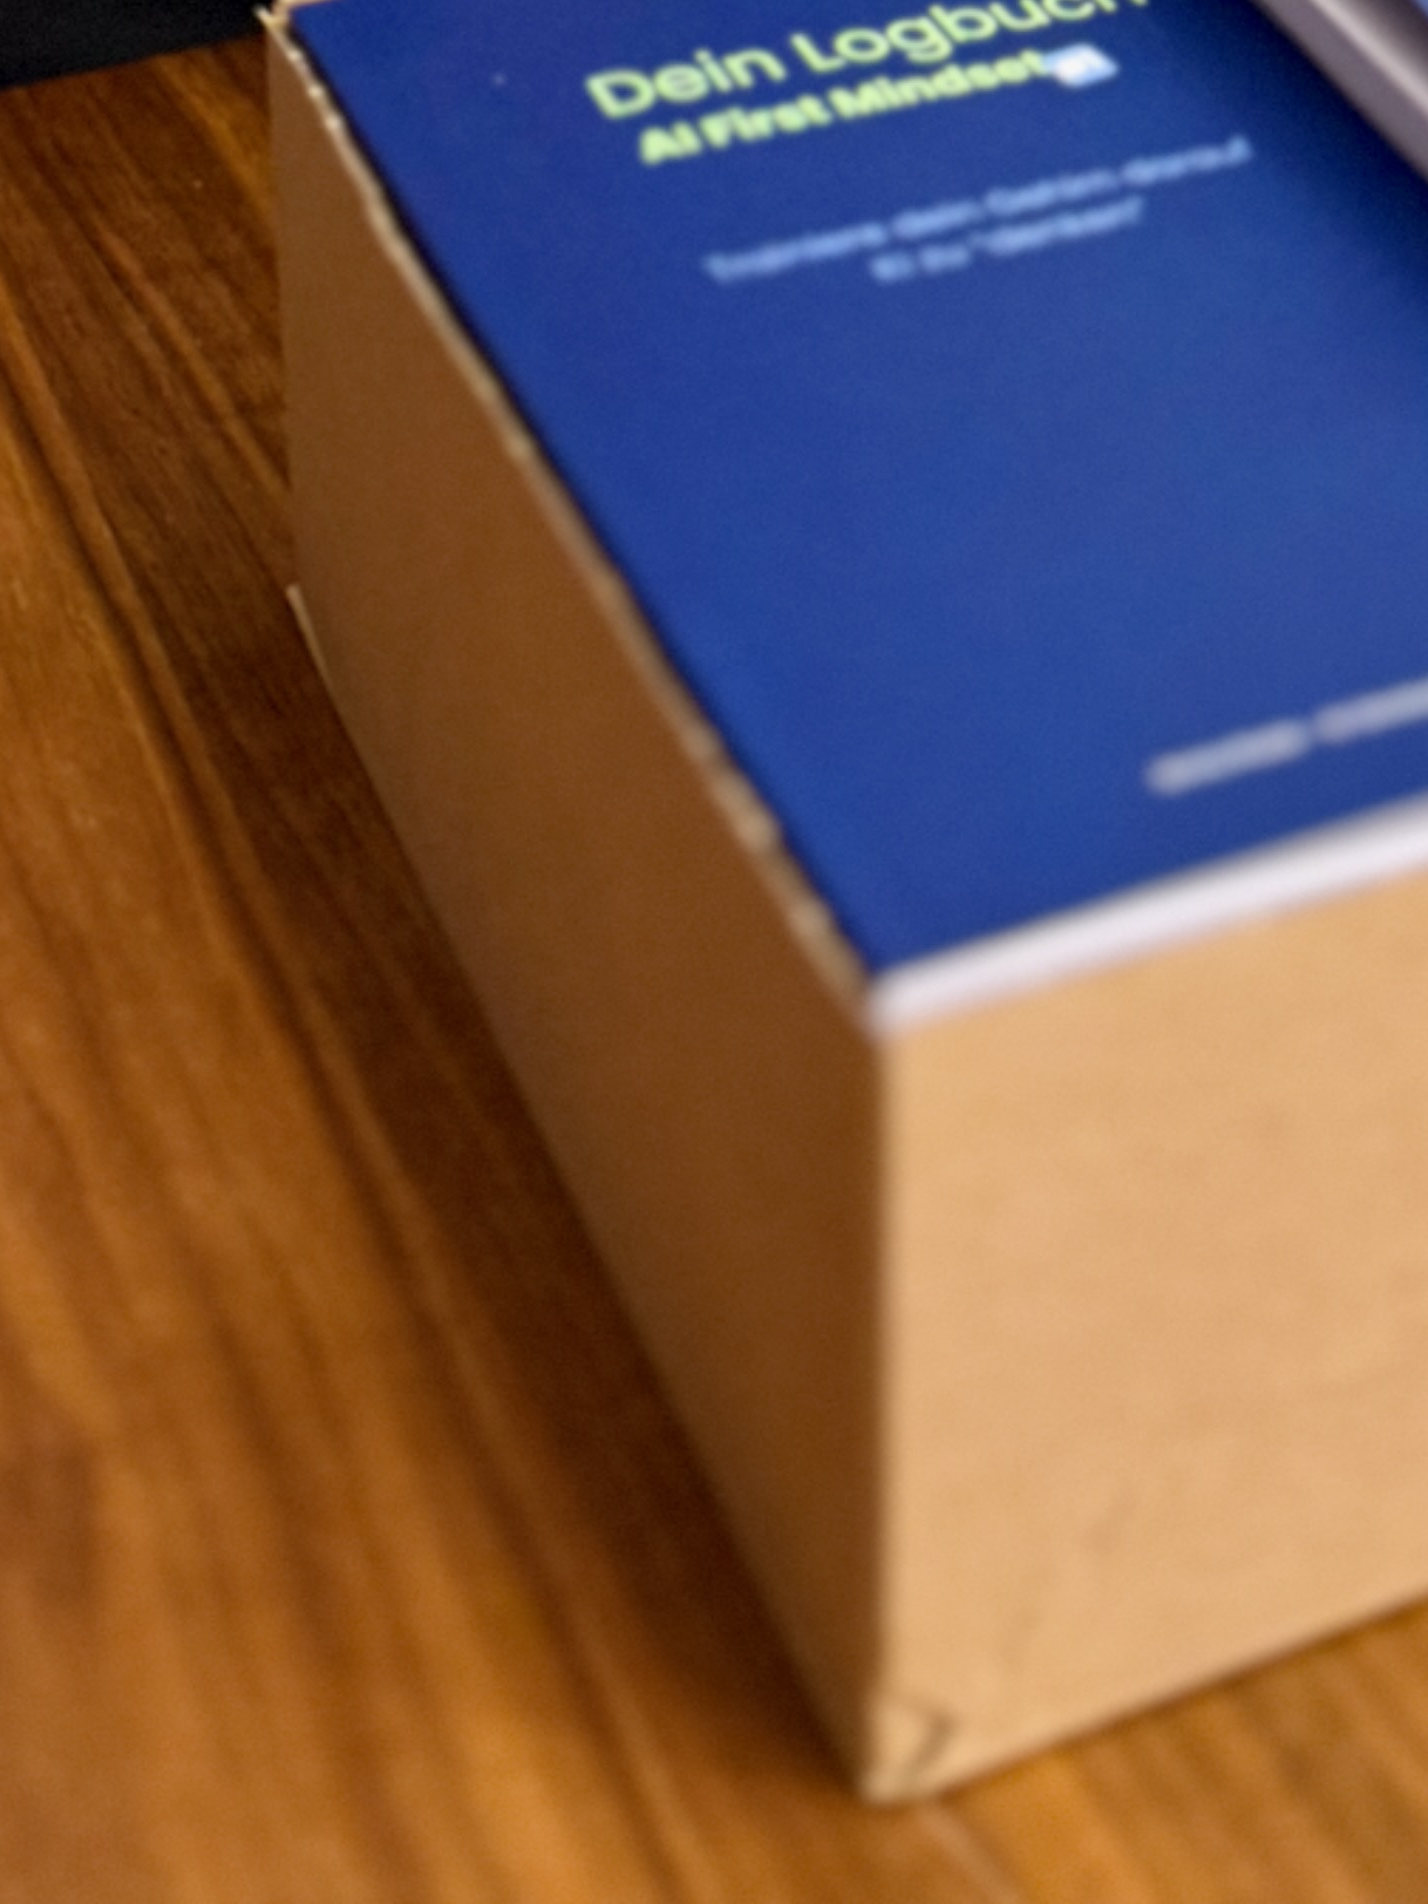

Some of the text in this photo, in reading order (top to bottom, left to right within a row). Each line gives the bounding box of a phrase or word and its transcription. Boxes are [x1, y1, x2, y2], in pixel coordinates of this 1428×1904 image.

[585, 46, 786, 119] Dein
[639, 48, 1050, 165] AI First Mindset
